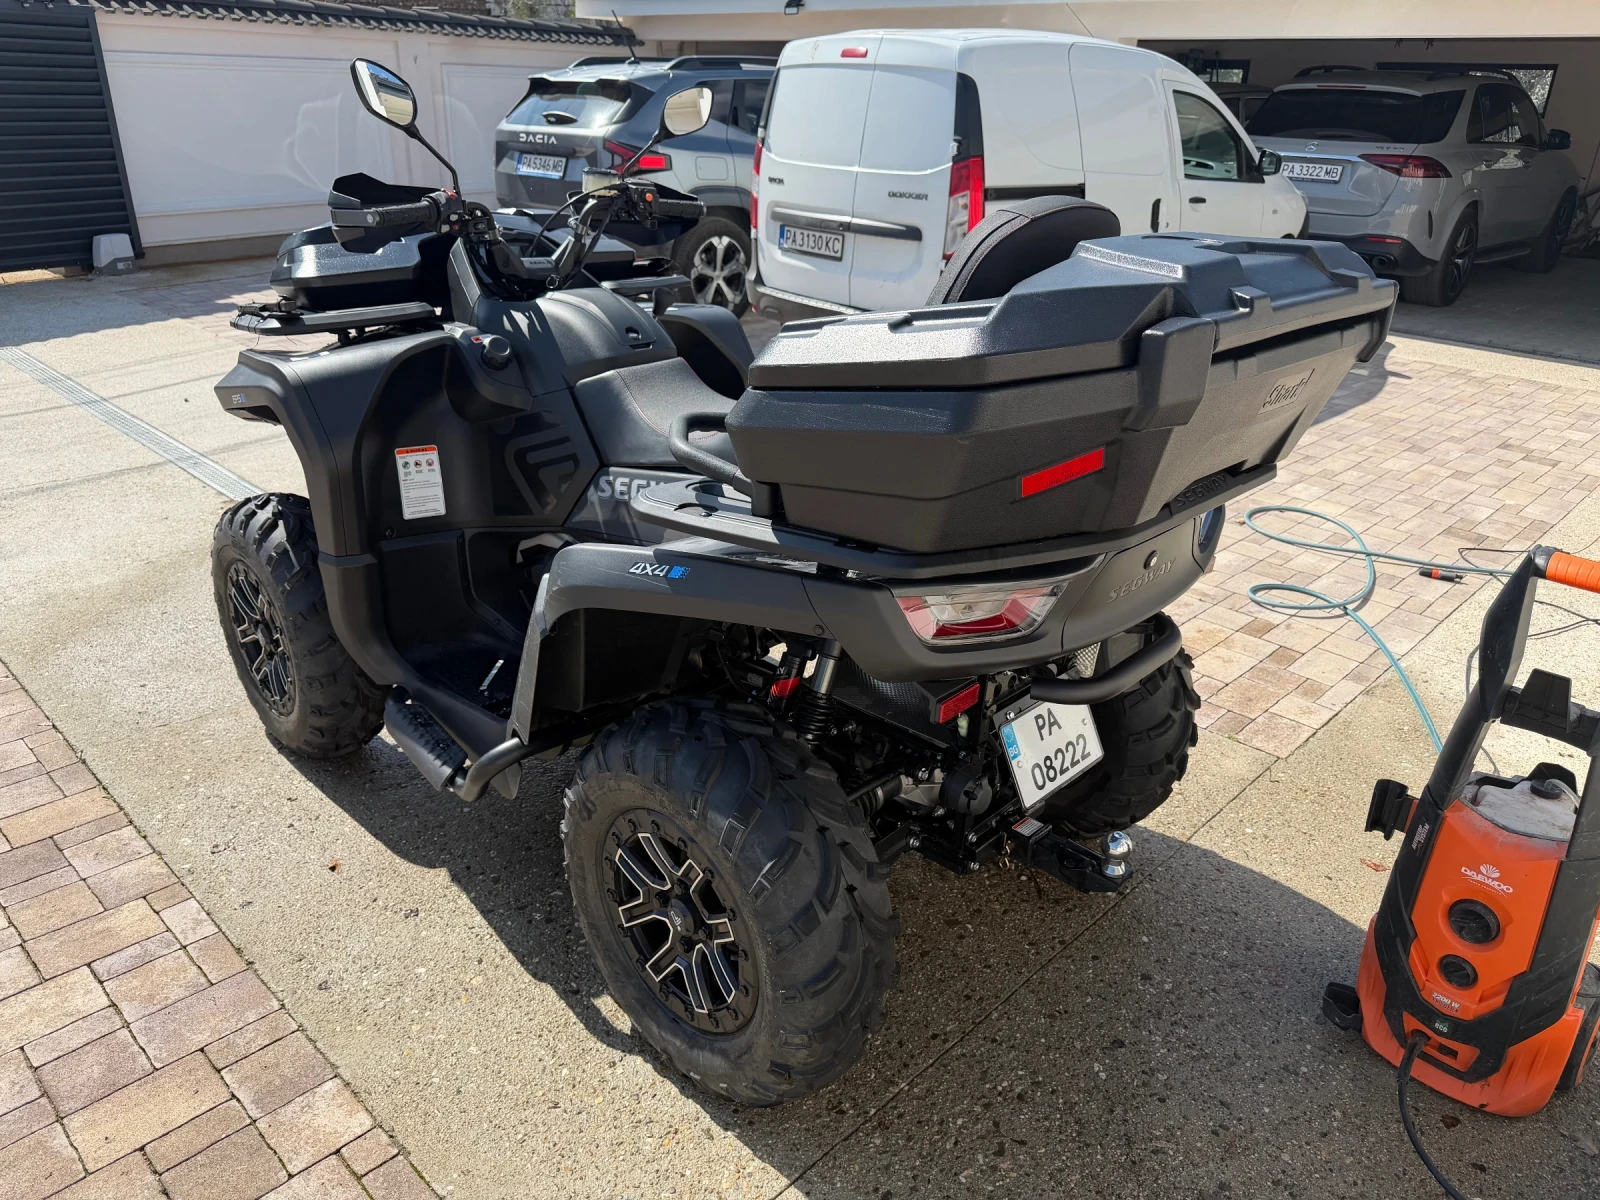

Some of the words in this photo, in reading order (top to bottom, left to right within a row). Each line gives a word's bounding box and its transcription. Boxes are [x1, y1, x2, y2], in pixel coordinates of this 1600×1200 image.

[519, 133, 557, 145] DACIA
[1282, 163, 1295, 176] PA
[1296, 164, 1322, 178] 3322
[1323, 166, 1339, 178] MB
[786, 229, 798, 247] PA
[798, 233, 824, 251] 3130
[825, 238, 841, 254] KC
[1176, 473, 1229, 507] SEGWAY
[1106, 557, 1177, 604] SEGWAY
[1034, 707, 1063, 741] PA
[1008, 744, 1019, 757] BG
[1031, 733, 1092, 791] 08222
[1461, 866, 1513, 893] DAEWOO
[1432, 992, 1451, 1004] 2200
[1434, 1022, 1448, 1033] eco
